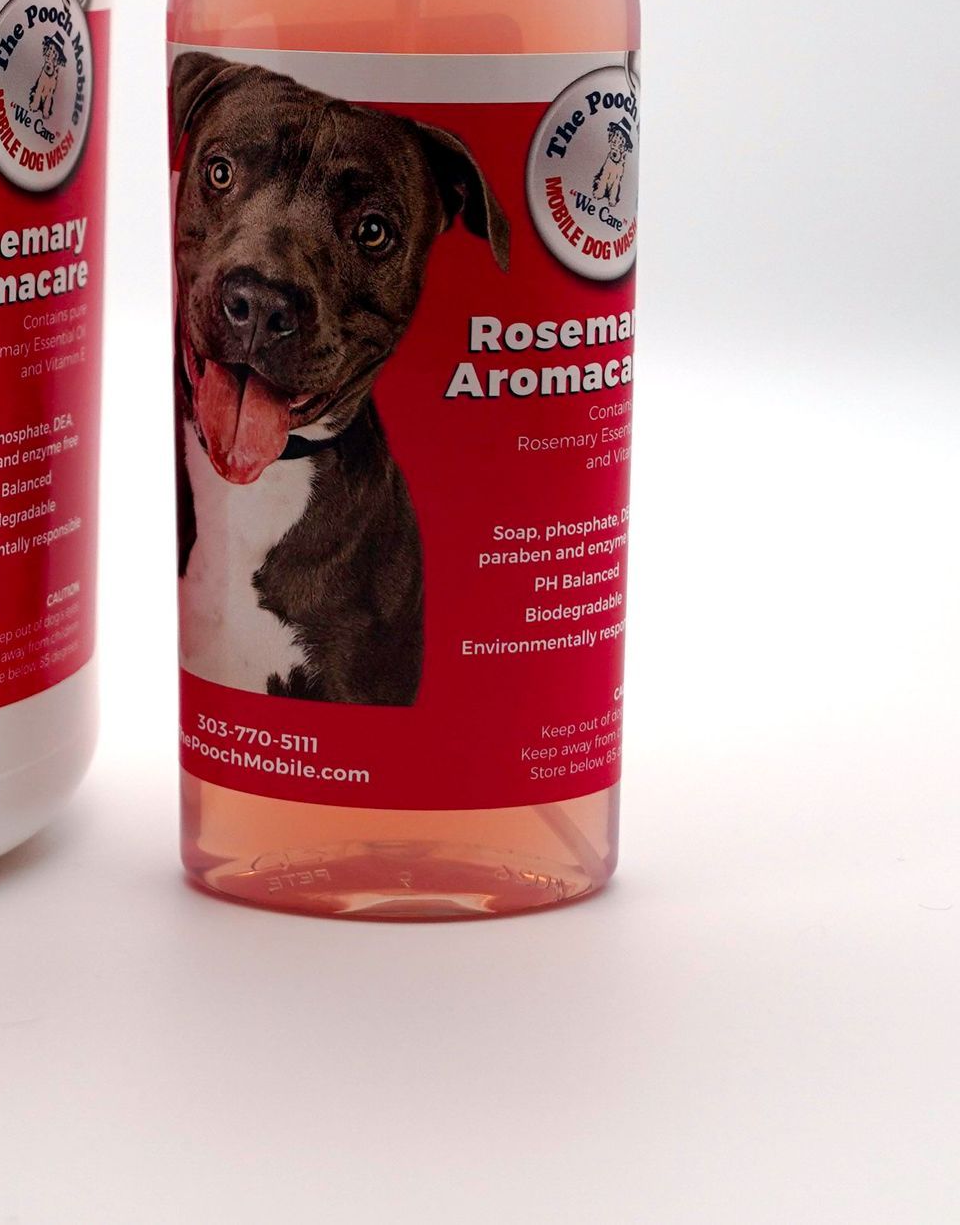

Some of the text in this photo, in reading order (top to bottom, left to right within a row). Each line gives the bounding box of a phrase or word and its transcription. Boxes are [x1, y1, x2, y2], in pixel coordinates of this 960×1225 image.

[24, 4, 75, 37] Pooch
[71, 31, 86, 127] Mobile
[10, 102, 32, 129] "We
[546, 90, 638, 160] The Pooch
[19, 146, 44, 172] DOG
[45, 129, 75, 170] WASH
[569, 188, 596, 216] "We
[544, 176, 585, 248] MOBILE
[581, 235, 612, 261] DOG
[23, 308, 69, 330] Contains
[20, 360, 42, 378] and
[22, 441, 62, 463] enzyme
[517, 433, 598, 451] Rosemary
[586, 449, 610, 470] and
[1, 470, 52, 498] Balanced
[493, 525, 541, 543] Soap,
[545, 514, 620, 542] phosphate,
[479, 548, 551, 568] paraben
[555, 541, 584, 560] and
[534, 561, 620, 592] PH Balanced
[525, 591, 623, 623] Biodegradable
[15, 624, 32, 639] out
[462, 629, 597, 656] Environmentally
[1, 647, 25, 661] away
[197, 713, 318, 753] 303-770-5111
[541, 724, 576, 739] Keep
[579, 718, 598, 732] out
[600, 711, 611, 726] of
[521, 747, 558, 761] Keep
[561, 739, 592, 755] away
[594, 731, 616, 749] from
[530, 764, 567, 780] Store
[569, 755, 605, 774] below
[606, 749, 616, 764] 85
